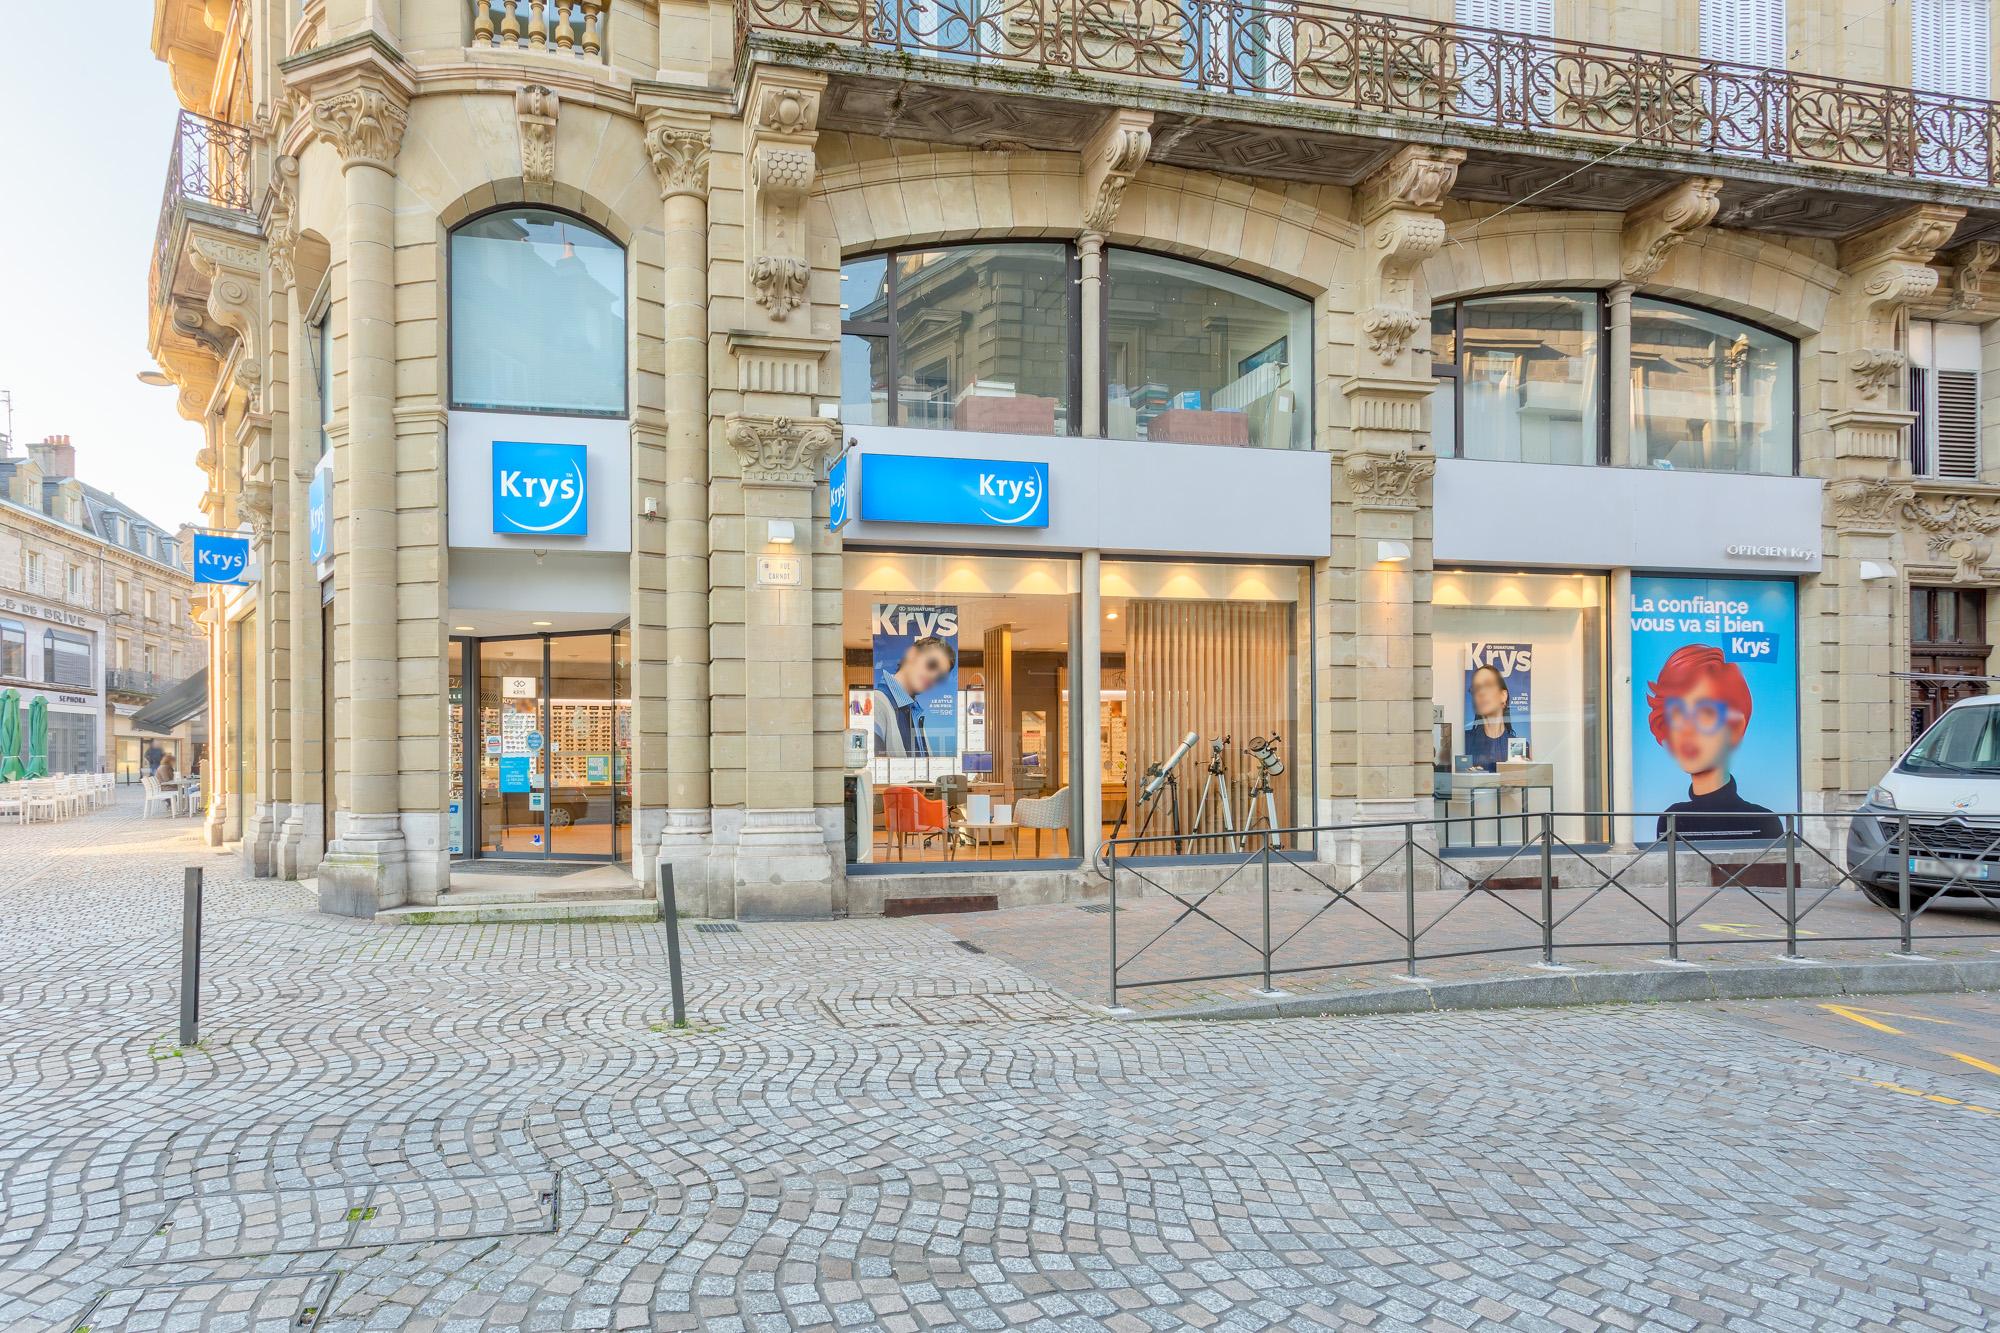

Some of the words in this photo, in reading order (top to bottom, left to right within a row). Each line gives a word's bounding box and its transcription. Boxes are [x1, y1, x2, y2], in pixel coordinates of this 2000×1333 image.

[500, 470, 575, 508] Krys
[830, 482, 845, 508] Krys
[979, 473, 1036, 505] Krys
[198, 549, 243, 571] Krys
[1727, 544, 1787, 557] OPTICIEN
[1791, 547, 1817, 561] Krys
[1631, 594, 1654, 613] La
[1657, 595, 1749, 614] confiance
[872, 604, 958, 643] Krys
[1631, 617, 1675, 632] vous
[1678, 619, 1701, 633] va
[1705, 616, 1720, 633] si
[1724, 617, 1764, 633] bien
[1731, 637, 1770, 658] Krys
[1464, 641, 1532, 678] Krys
[59, 694, 87, 705] SEPHORA
